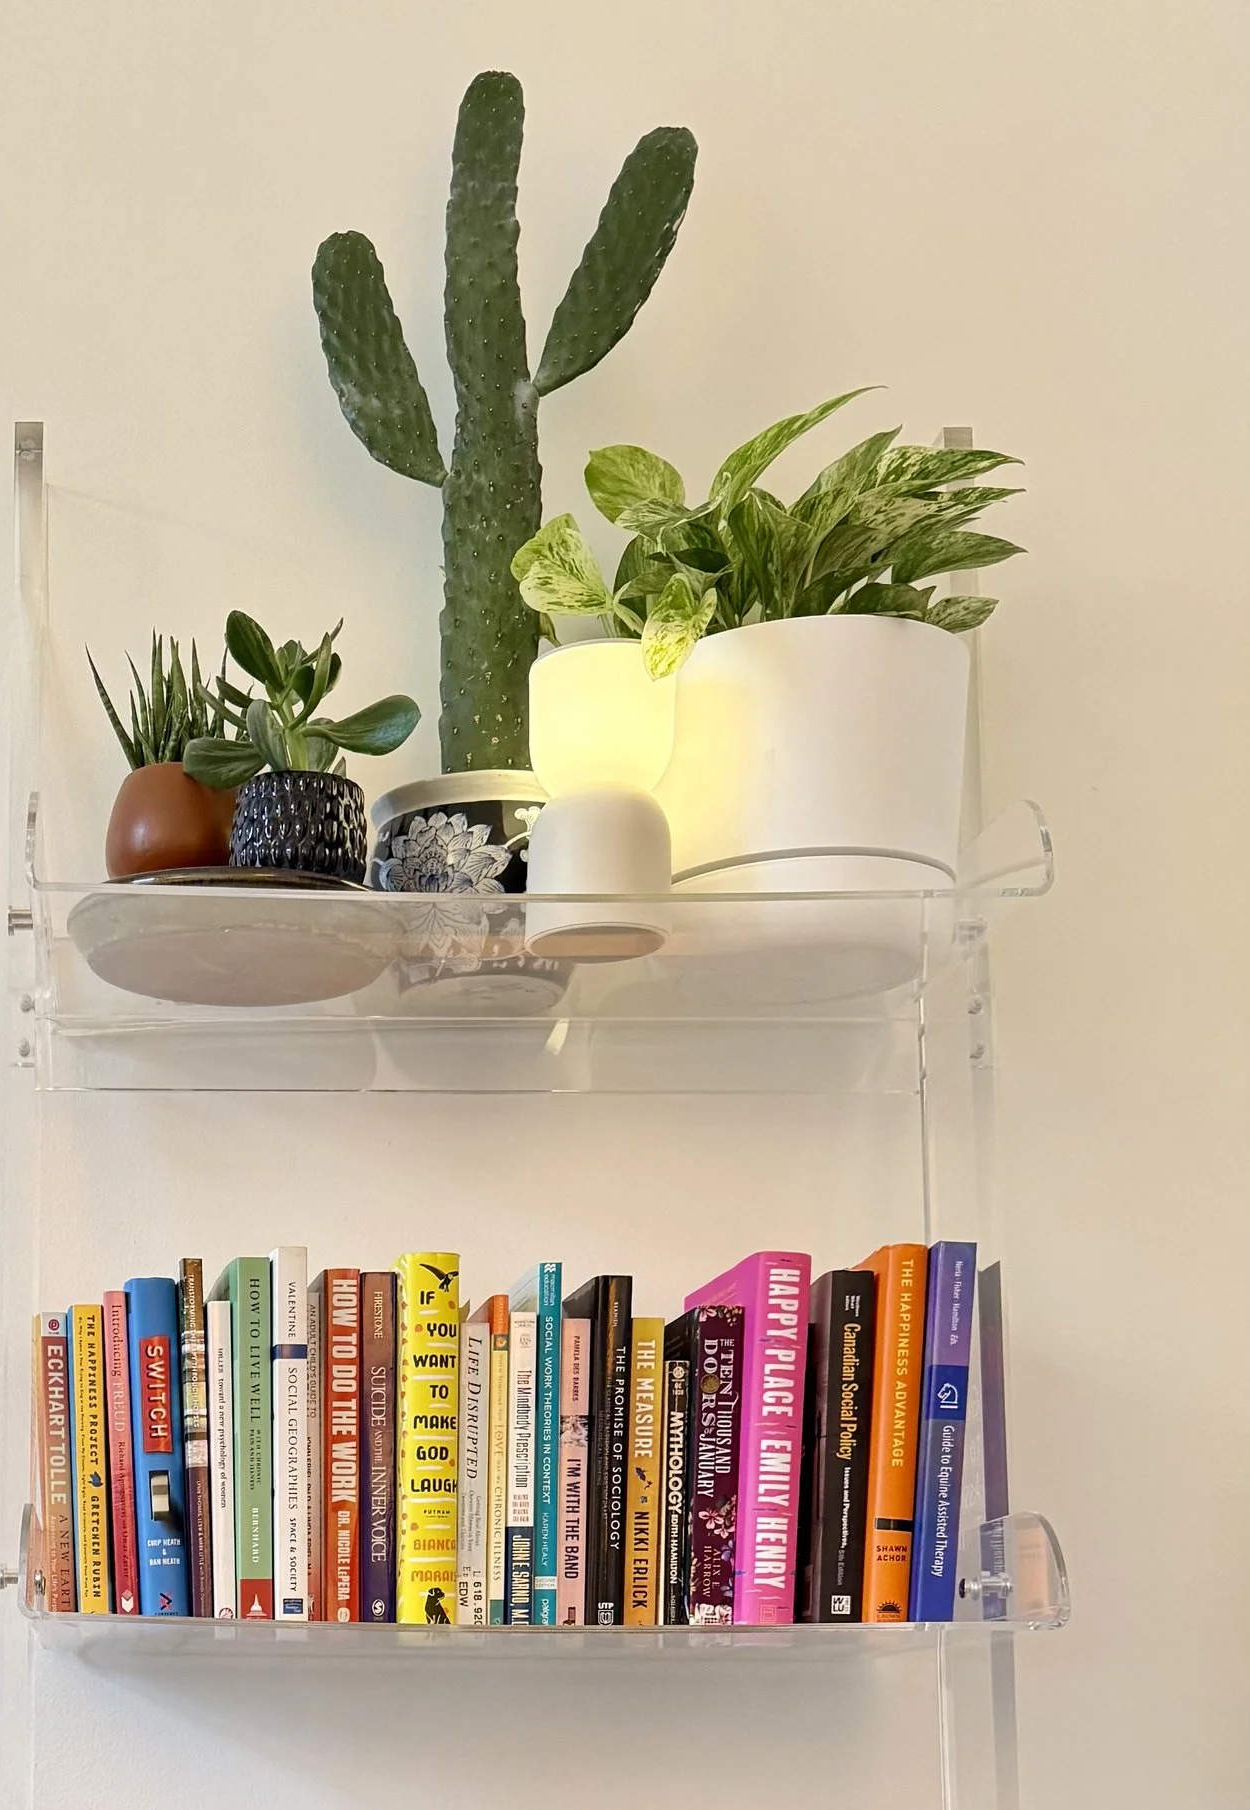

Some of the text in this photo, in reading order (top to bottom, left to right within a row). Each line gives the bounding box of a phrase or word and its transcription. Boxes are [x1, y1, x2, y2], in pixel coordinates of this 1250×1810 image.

[287, 1282, 296, 1338] VALENTINE
[420, 1291, 435, 1305] IF
[427, 1324, 457, 1338] YOU
[763, 1268, 800, 1417] HAPPY PLACE
[87, 1315, 99, 1465] THE HAPPINESS PROJECT
[110, 1304, 125, 1431] Introducing FREUD
[147, 1345, 168, 1437] SWITCH
[218, 1378, 226, 1402] toward
[249, 1278, 261, 1423] HOW TO LIVE WELL
[331, 1280, 357, 1503] HOW TO DO THE WORK
[413, 1354, 457, 1368] WANT
[430, 1385, 450, 1399] TO
[836, 1323, 861, 1460] Canadian Social Policy
[47, 1344, 67, 1505] ECKHART TOLLE
[217, 1429, 226, 1470] psychology
[287, 1367, 299, 1510] SOCIAL GEOGRAPHIES
[414, 1415, 457, 1430] MAKE
[416, 1446, 450, 1460] GOD
[514, 1370, 532, 1488] The Mindbody Prescription
[542, 1316, 553, 1504] SOCIAL WORK THEORIES IN CONTEXT
[371, 1366, 386, 1562] SUICIDE AND THE INNER VOICE
[669, 1412, 684, 1513] MYTHOLOGY
[930, 1426, 954, 1577] Guide to Equine Assisted Therapy
[90, 1496, 102, 1598] GRETCHEN RUBIN
[252, 1508, 260, 1562] BERNHARD
[632, 1511, 649, 1608] NIKKI ERLICK
[757, 1439, 792, 1589] EMILY HENRY
[458, 1582, 468, 1607] EDW
